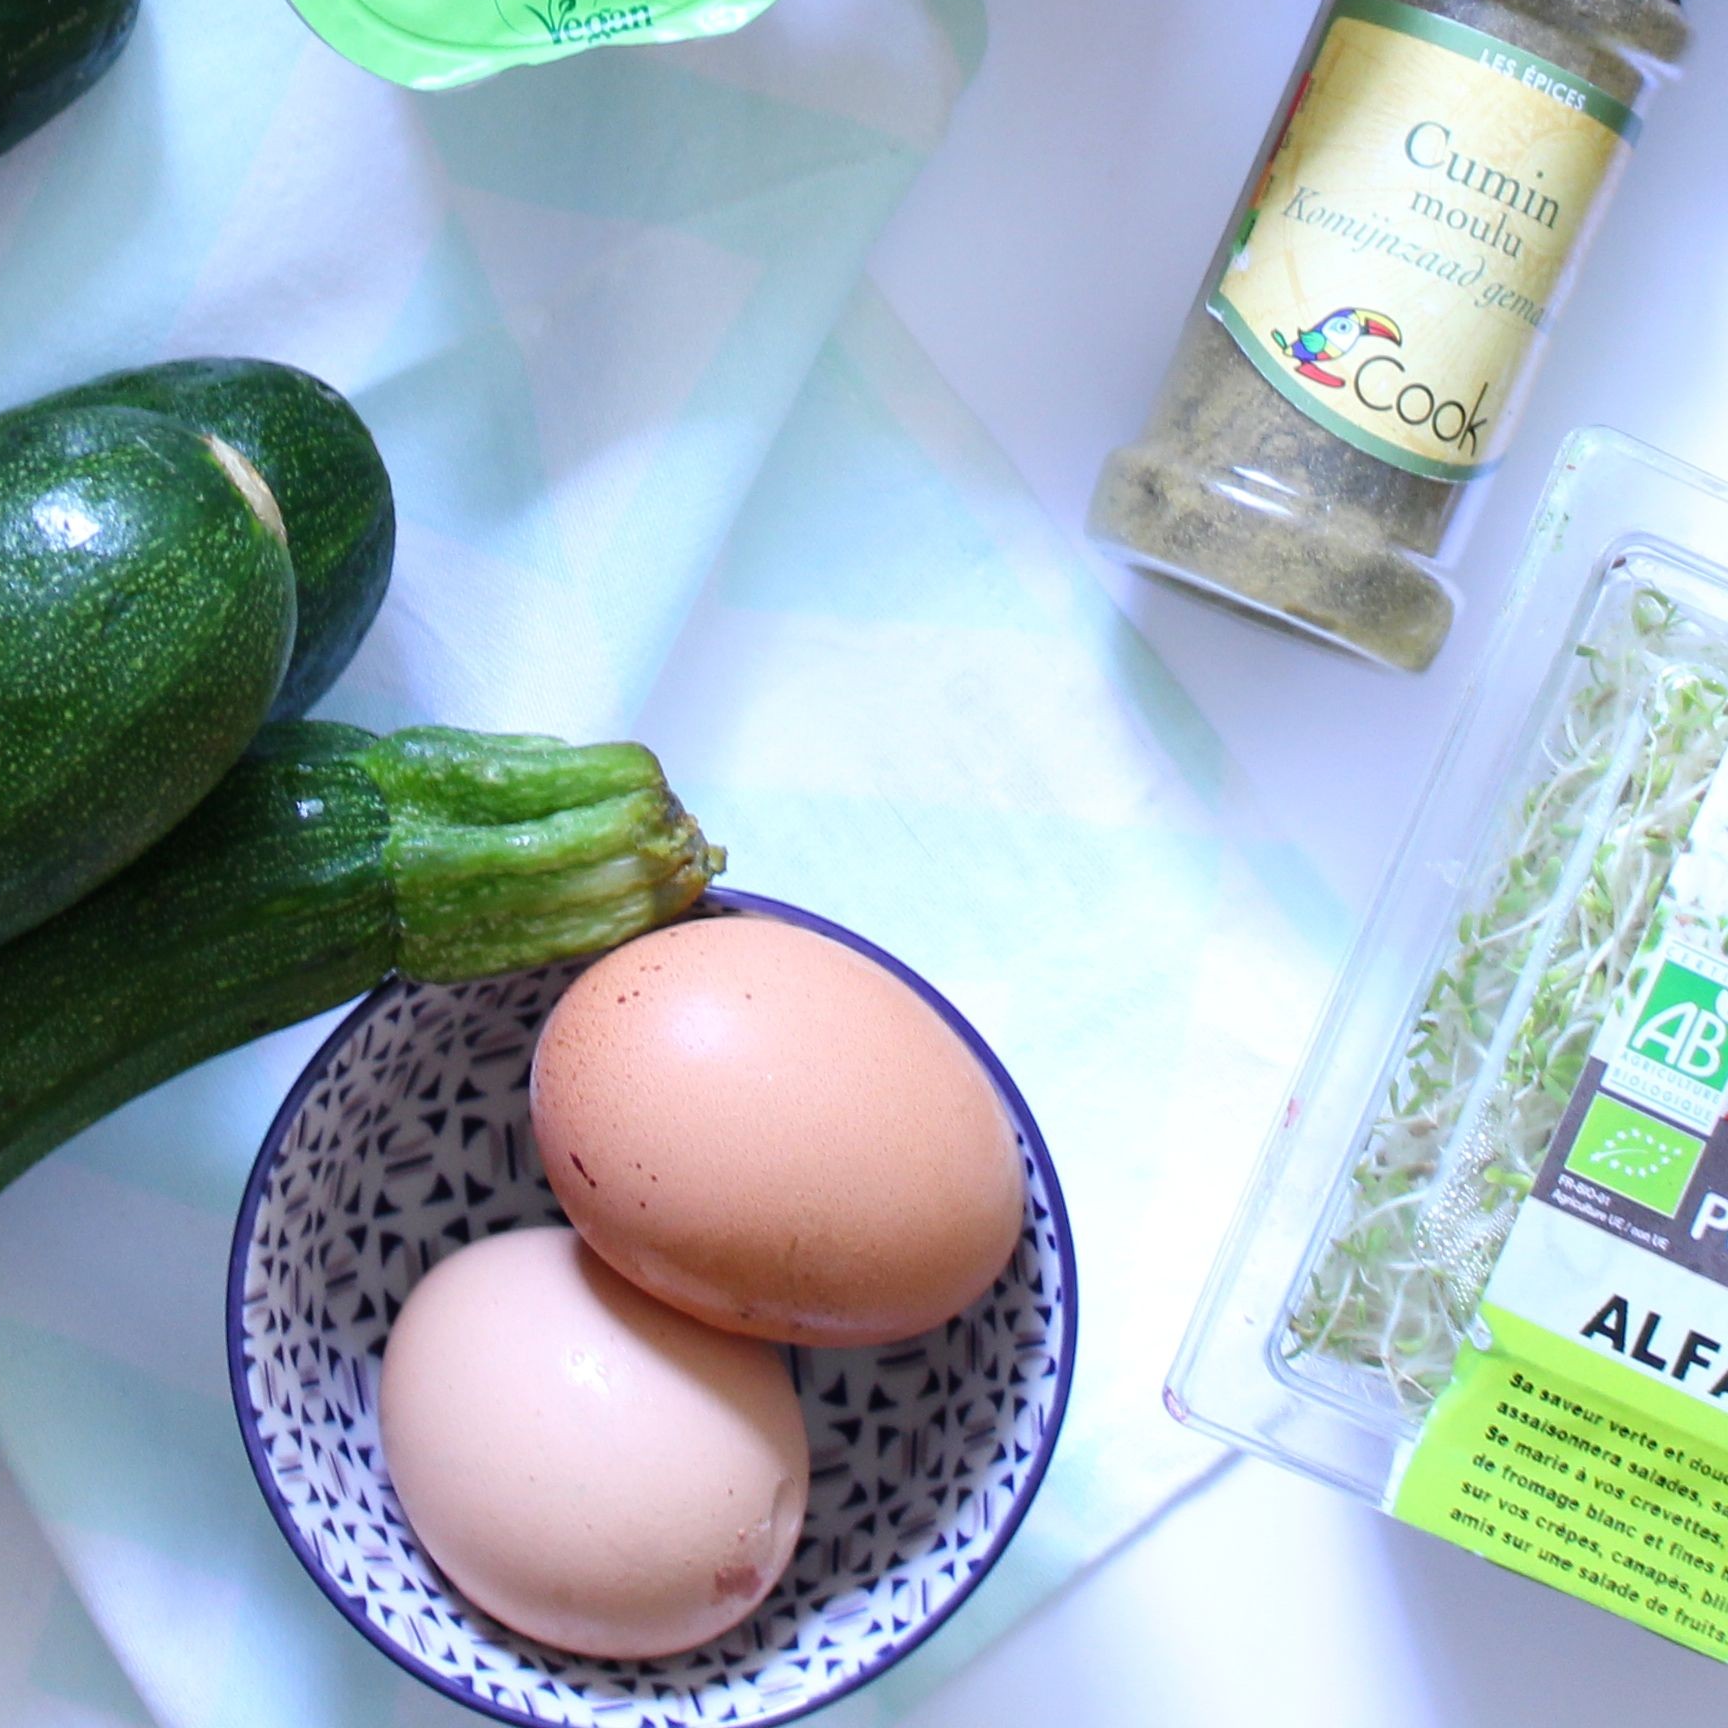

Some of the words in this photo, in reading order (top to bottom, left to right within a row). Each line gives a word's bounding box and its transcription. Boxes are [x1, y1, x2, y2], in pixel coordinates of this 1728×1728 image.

[1479, 47, 1517, 77] LES
[1405, 120, 1560, 231] Cumin
[1281, 185, 1486, 289] Komijnzaad
[1473, 280, 1546, 327] gema
[1409, 188, 1524, 259] moulu
[1354, 355, 1490, 458] Cook
[1620, 1051, 1721, 1105] AGRICULTURE
[1631, 1001, 1727, 1078] AB
[1613, 1067, 1712, 1122] BIOLOGIQUE
[1551, 1188, 1608, 1223] Agriculture
[1496, 1400, 1622, 1468] assaisonnera
[1627, 1459, 1703, 1508] salades,
[1509, 1371, 1534, 1395] Sa
[1539, 1388, 1604, 1425] saveur
[1609, 1418, 1659, 1451] verte
[1663, 1445, 1685, 1464] et
[1461, 1480, 1492, 1504] sur
[1498, 1496, 1530, 1522] vos
[1472, 1452, 1496, 1474] de
[1501, 1464, 1580, 1513] fromage
[1585, 1502, 1638, 1540] blanc
[1643, 1530, 1664, 1551] et
[1668, 1539, 1716, 1575] fines
[1484, 1424, 1510, 1449] Se
[1513, 1440, 1570, 1474] marie
[1574, 1466, 1587, 1483] à
[1593, 1475, 1626, 1501] vos
[1629, 1492, 1725, 1551] crevettes,
[1450, 1506, 1497, 1538] amis
[1501, 1530, 1533, 1554] sur
[1537, 1549, 1574, 1572] une
[1577, 1566, 1640, 1603] salade
[1645, 1595, 1668, 1617] de
